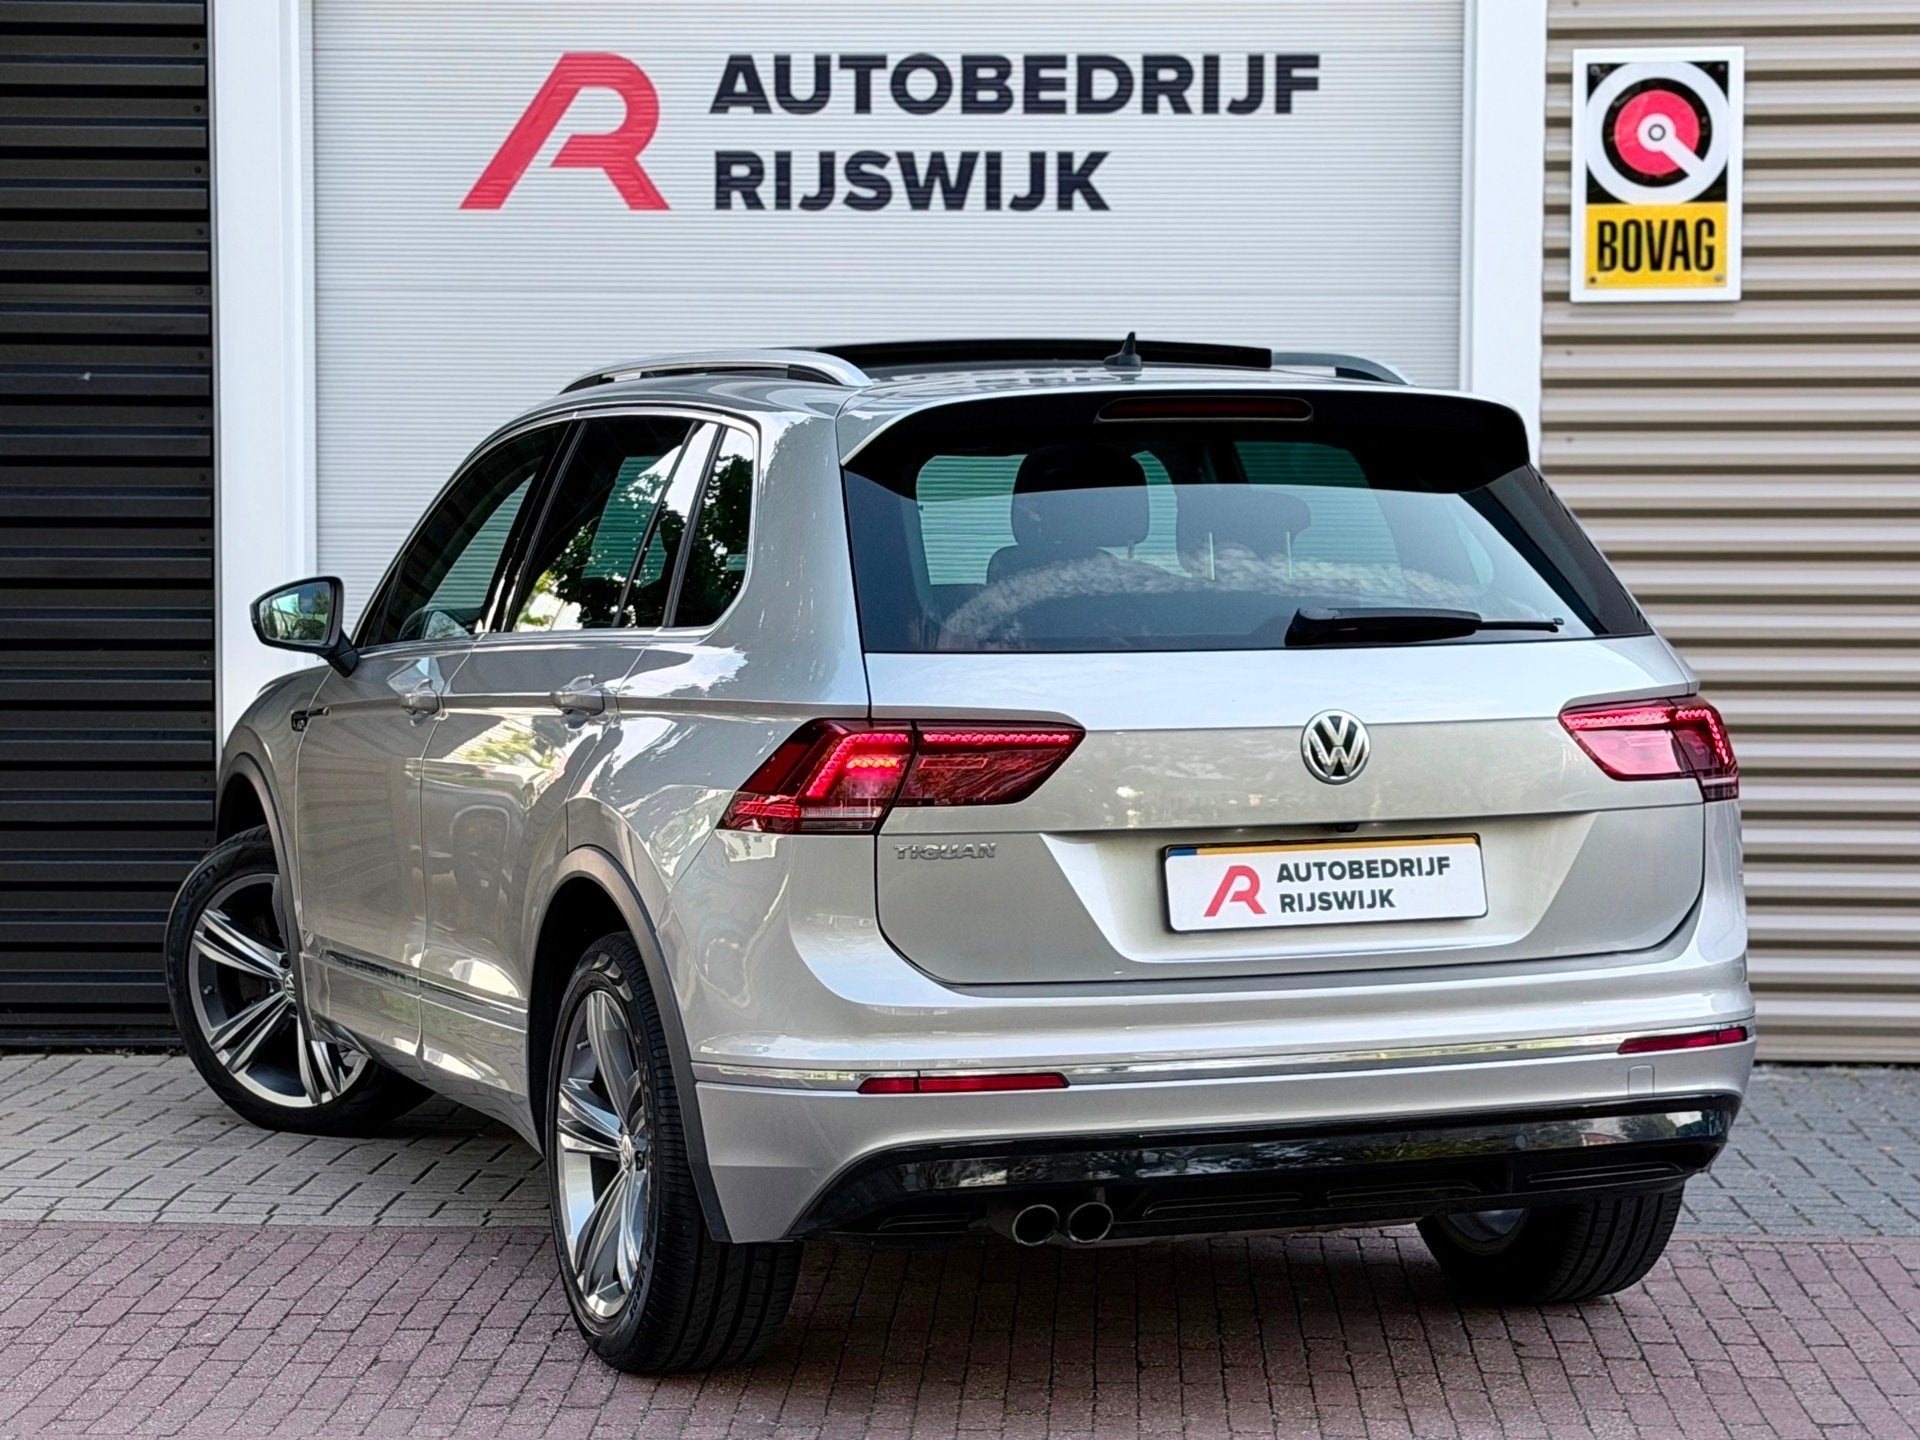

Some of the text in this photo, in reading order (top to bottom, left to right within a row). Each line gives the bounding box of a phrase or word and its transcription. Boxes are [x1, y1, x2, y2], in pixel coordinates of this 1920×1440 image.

[710, 52, 1320, 116] AUTOBEDRIJF
[715, 150, 1110, 212] RIJSWIJK
[1597, 217, 1716, 273] BOVAG
[894, 842, 997, 860] TIGUAN
[1277, 856, 1450, 883] AUTOBEDRIJF
[1280, 888, 1396, 914] RIJSWIJK
